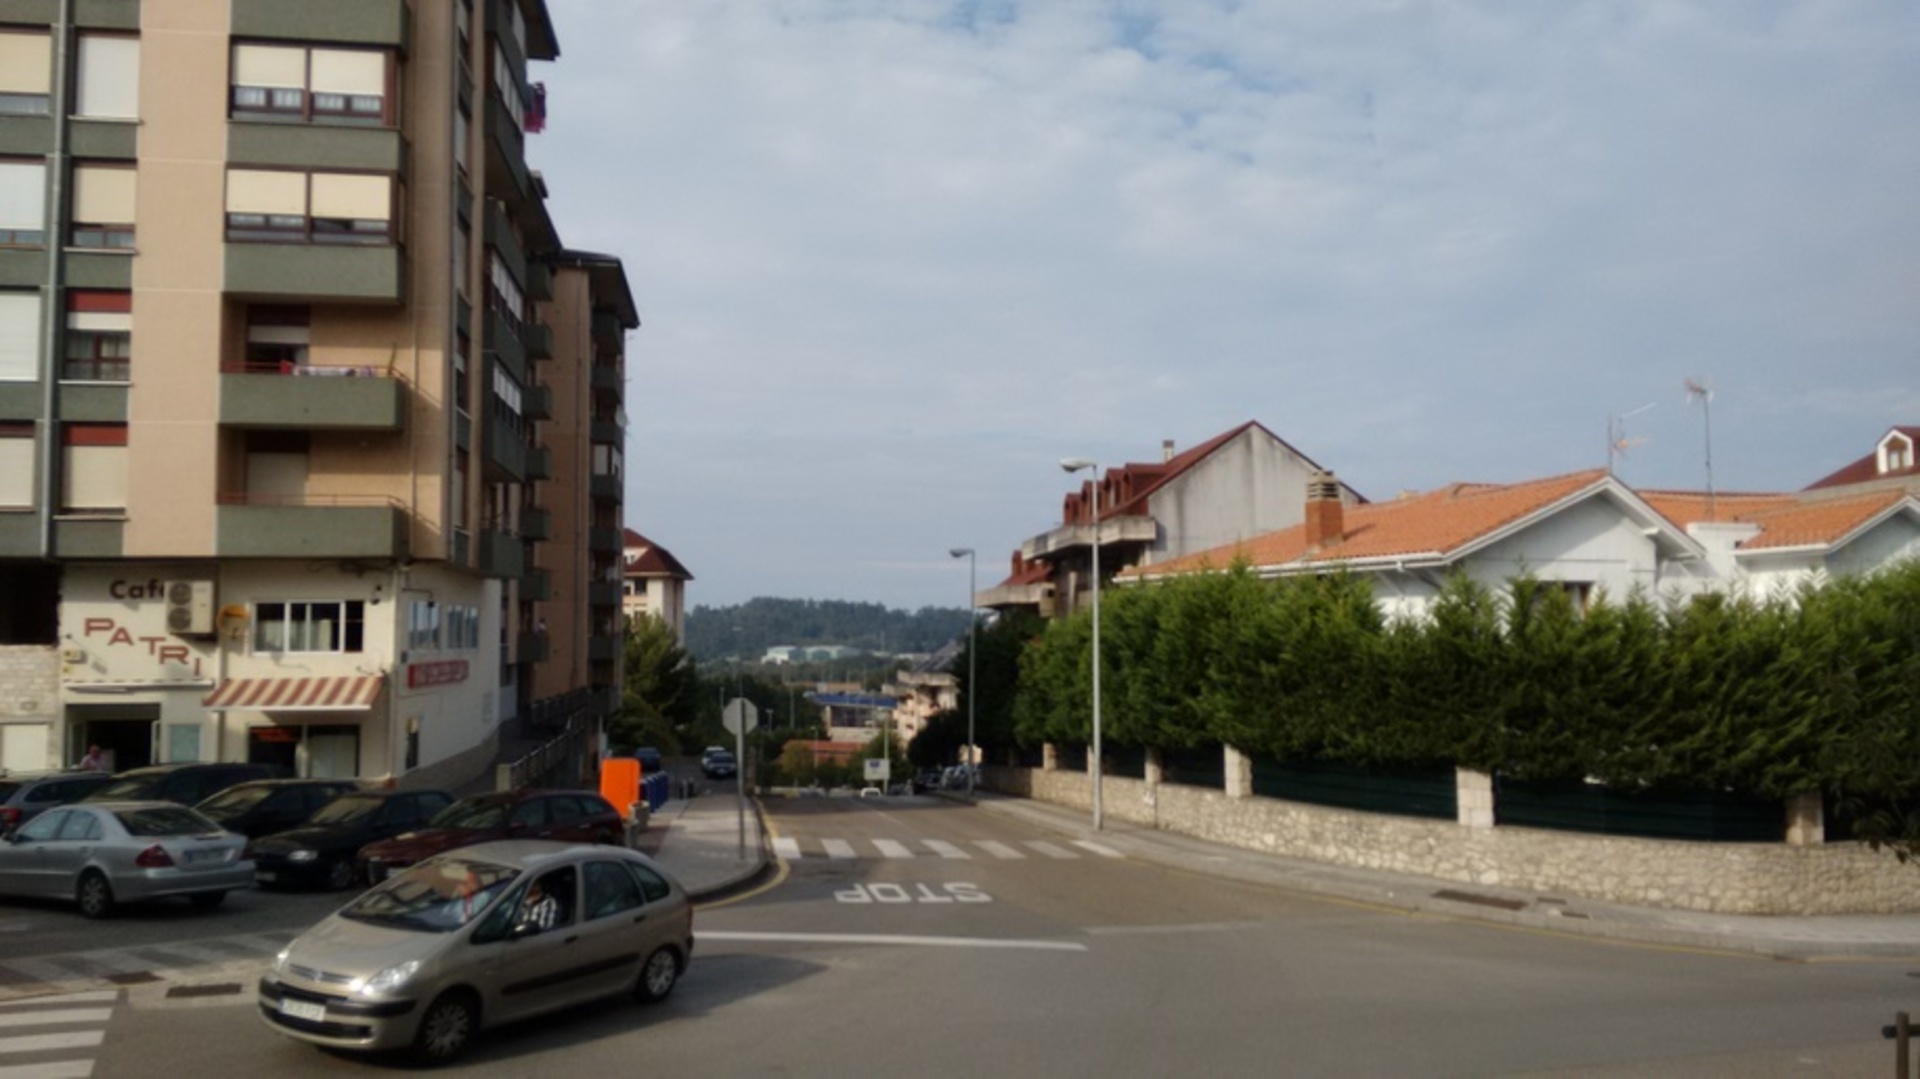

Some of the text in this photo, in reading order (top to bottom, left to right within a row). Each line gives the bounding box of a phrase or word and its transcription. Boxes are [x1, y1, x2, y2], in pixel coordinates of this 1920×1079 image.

[110, 578, 164, 600] Caf
[84, 618, 201, 677] PATRI
[833, 882, 993, 903] STOP
